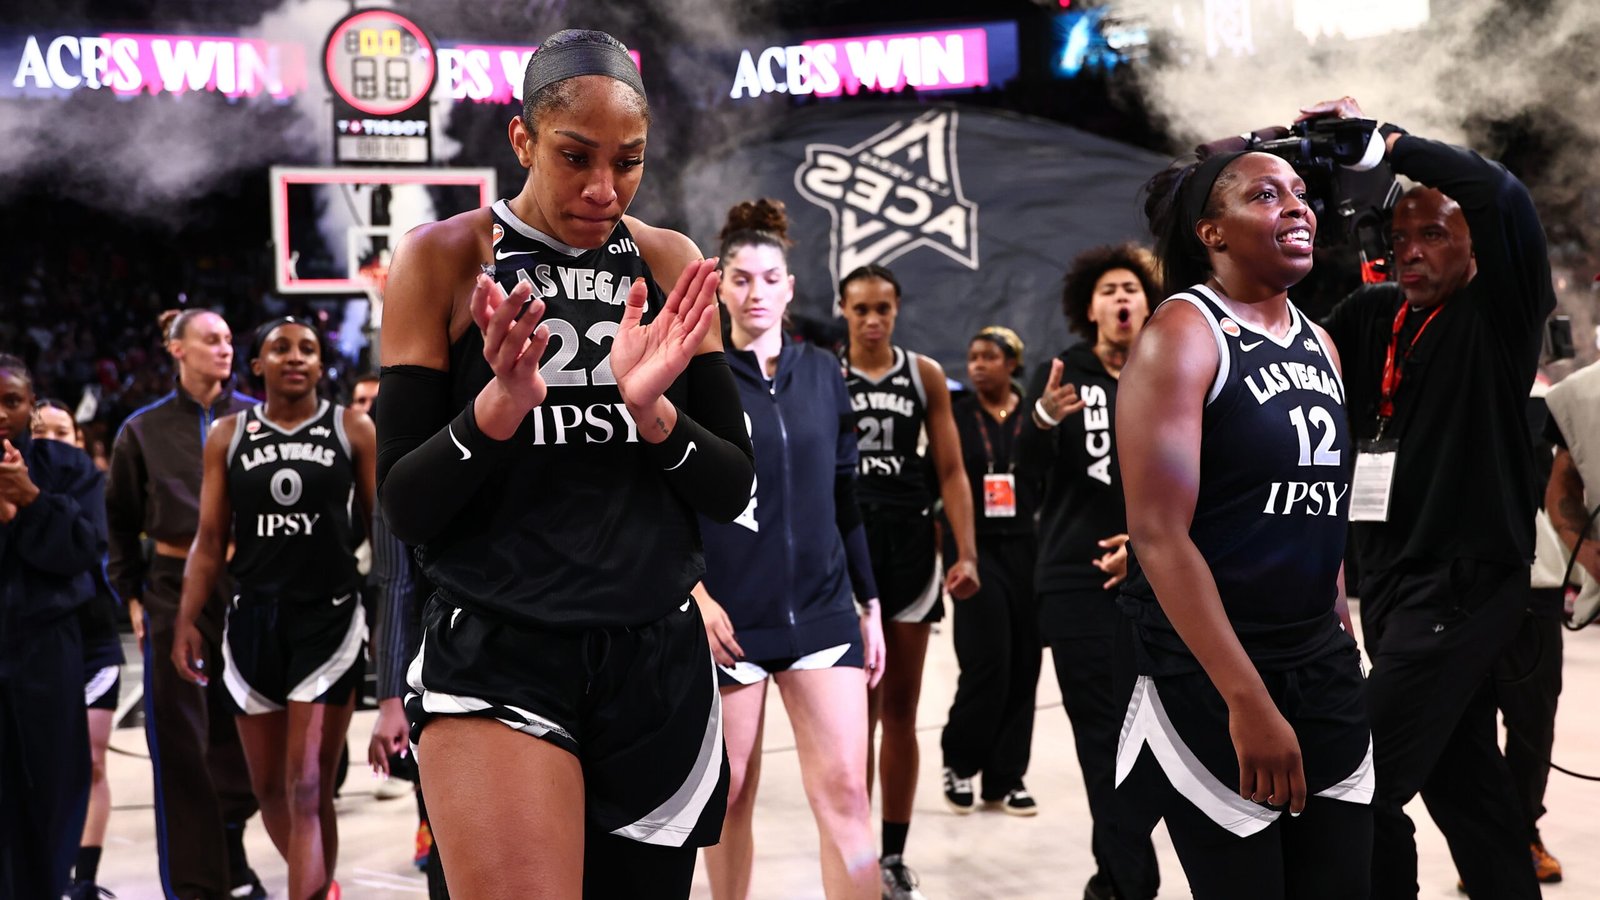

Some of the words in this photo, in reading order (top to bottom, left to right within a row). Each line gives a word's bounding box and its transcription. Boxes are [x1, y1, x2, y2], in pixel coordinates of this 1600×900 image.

[12, 34, 142, 90] ACES
[151, 39, 283, 94] WIN
[729, 48, 840, 99] ACES
[845, 34, 965, 89] WIN
[556, 266, 649, 314] VEGA
[532, 318, 618, 388] 22
[1244, 363, 1291, 406] LAS
[1281, 361, 1342, 406] VEGAS
[532, 403, 641, 446] IPSY
[857, 416, 895, 451] 21
[1080, 384, 1112, 486] ACES
[1288, 405, 1341, 467] 12
[240, 444, 278, 472] LAS
[278, 441, 336, 468] VEGAS
[855, 455, 905, 476] PSY
[269, 467, 303, 507] 0
[1263, 481, 1349, 517] IPSY
[256, 512, 321, 537] IPSY
